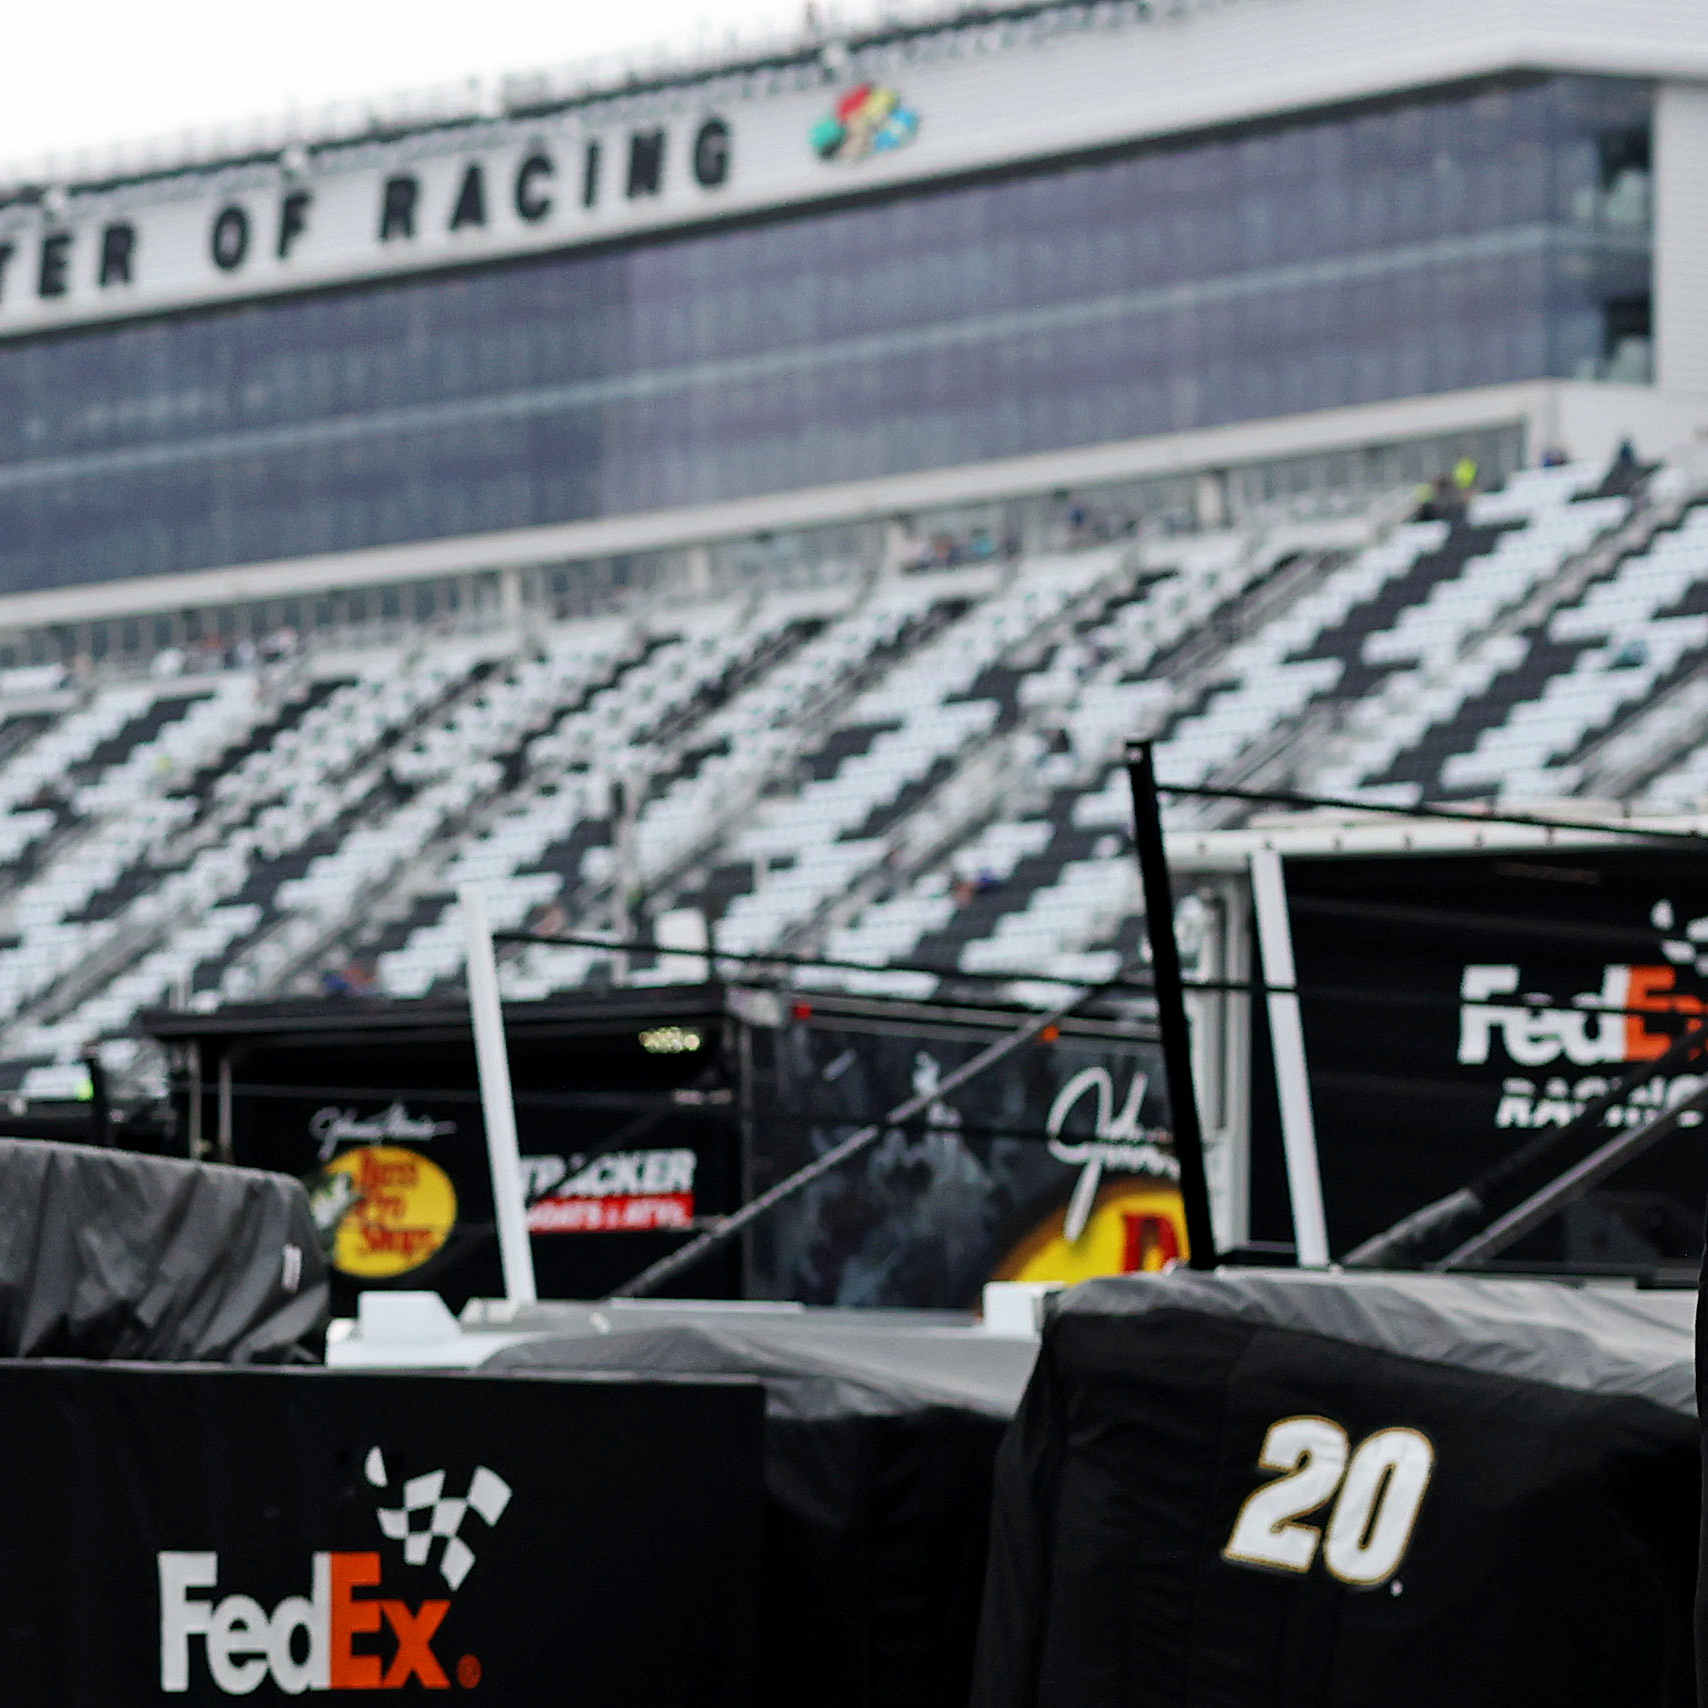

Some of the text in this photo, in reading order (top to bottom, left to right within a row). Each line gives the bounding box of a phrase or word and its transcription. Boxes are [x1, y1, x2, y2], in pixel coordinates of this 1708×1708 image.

[208, 189, 311, 273] OF
[379, 115, 731, 243] RACING
[1223, 1414, 1437, 1587] 20
